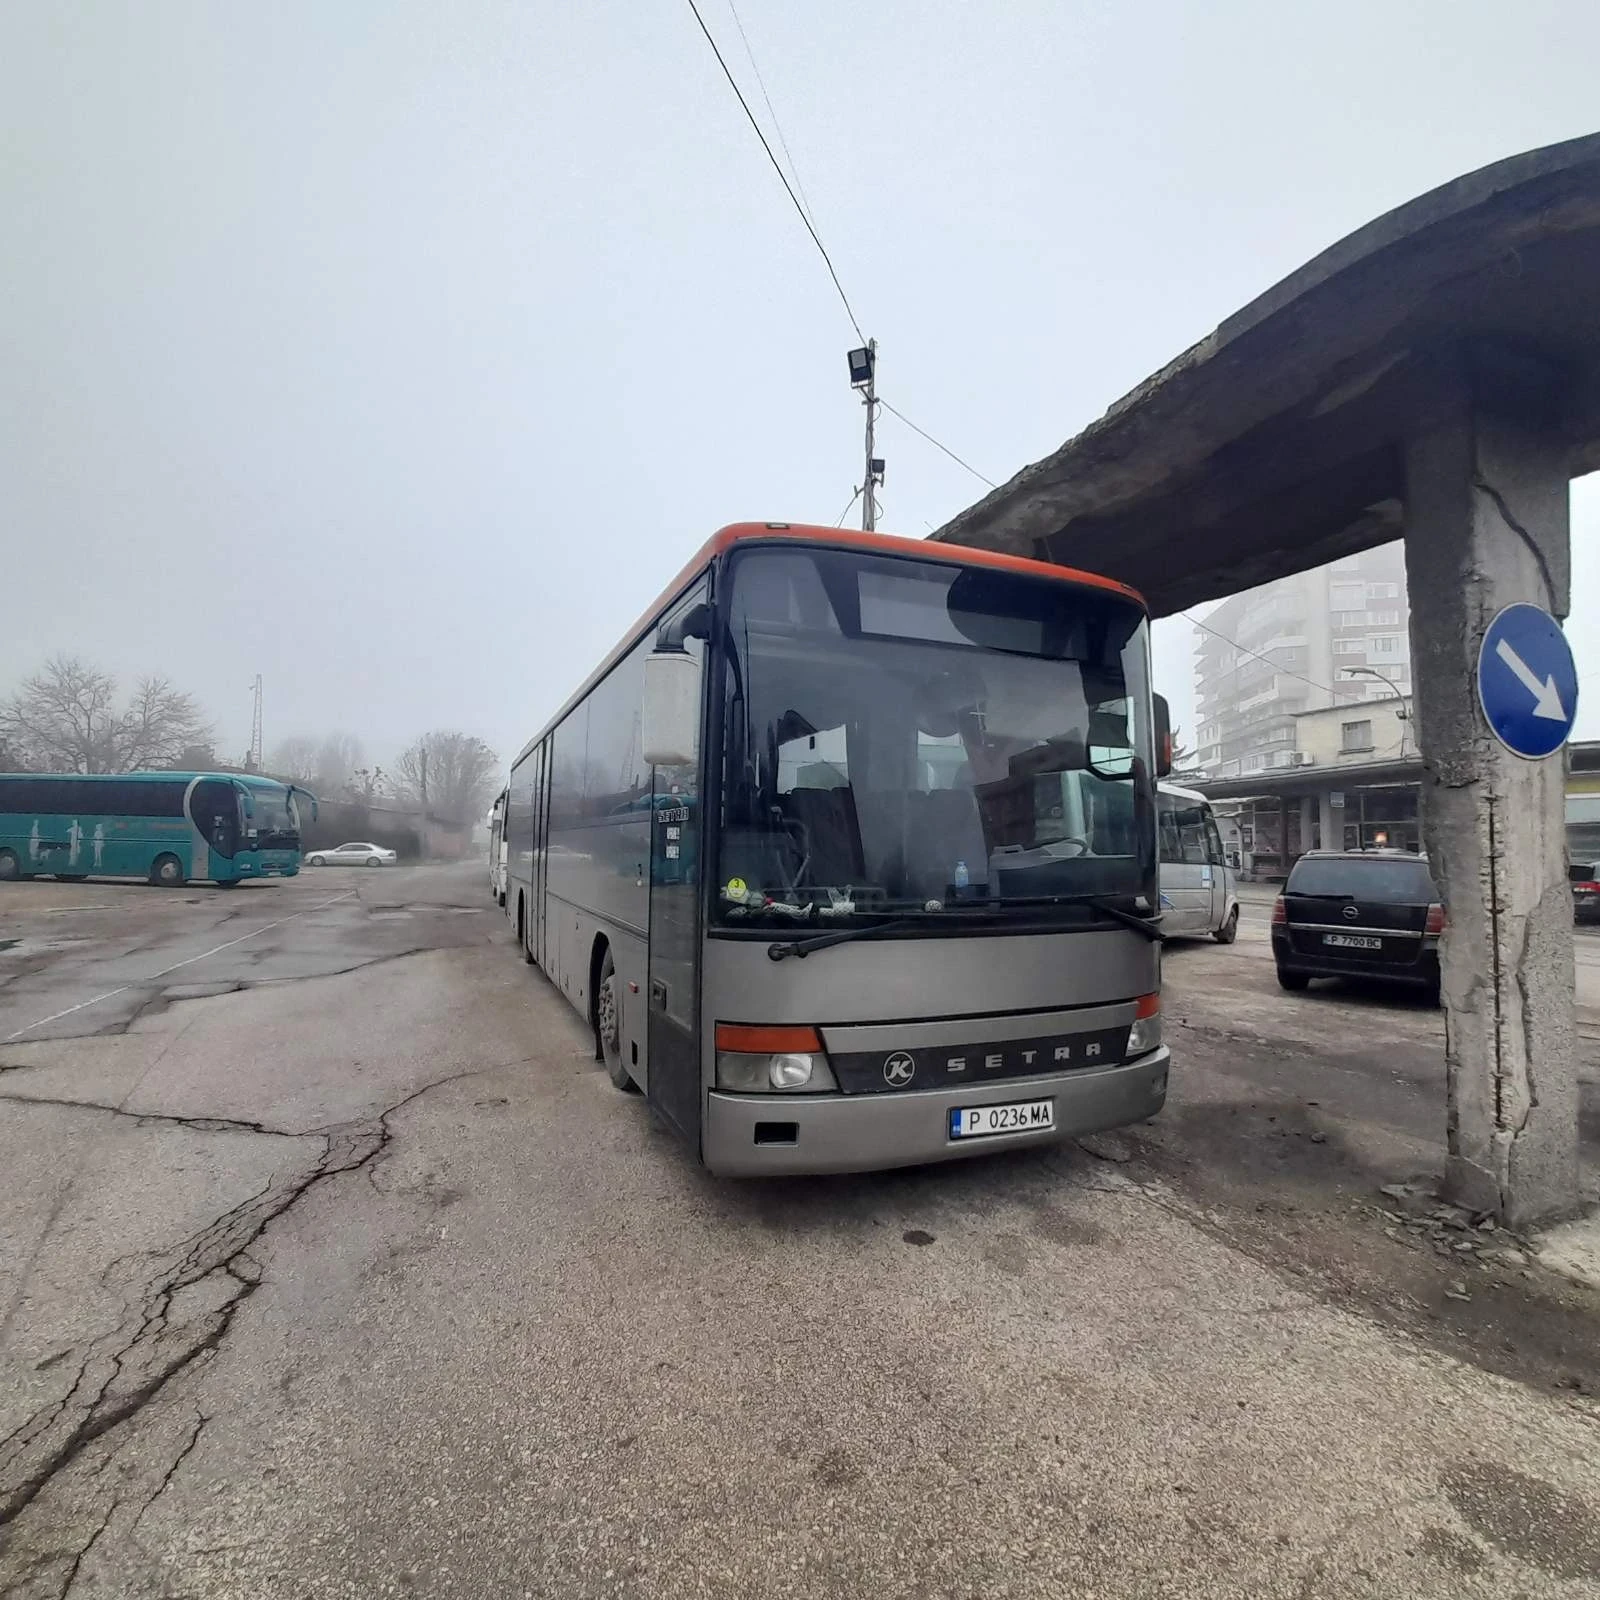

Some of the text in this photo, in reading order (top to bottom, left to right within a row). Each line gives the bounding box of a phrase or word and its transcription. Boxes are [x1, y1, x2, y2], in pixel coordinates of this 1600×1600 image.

[733, 878, 741, 888] 3
[1331, 935, 1380, 948] P 7700 BC
[946, 1042, 1102, 1072] SETRA
[969, 1104, 1050, 1131] P 0236 MA
